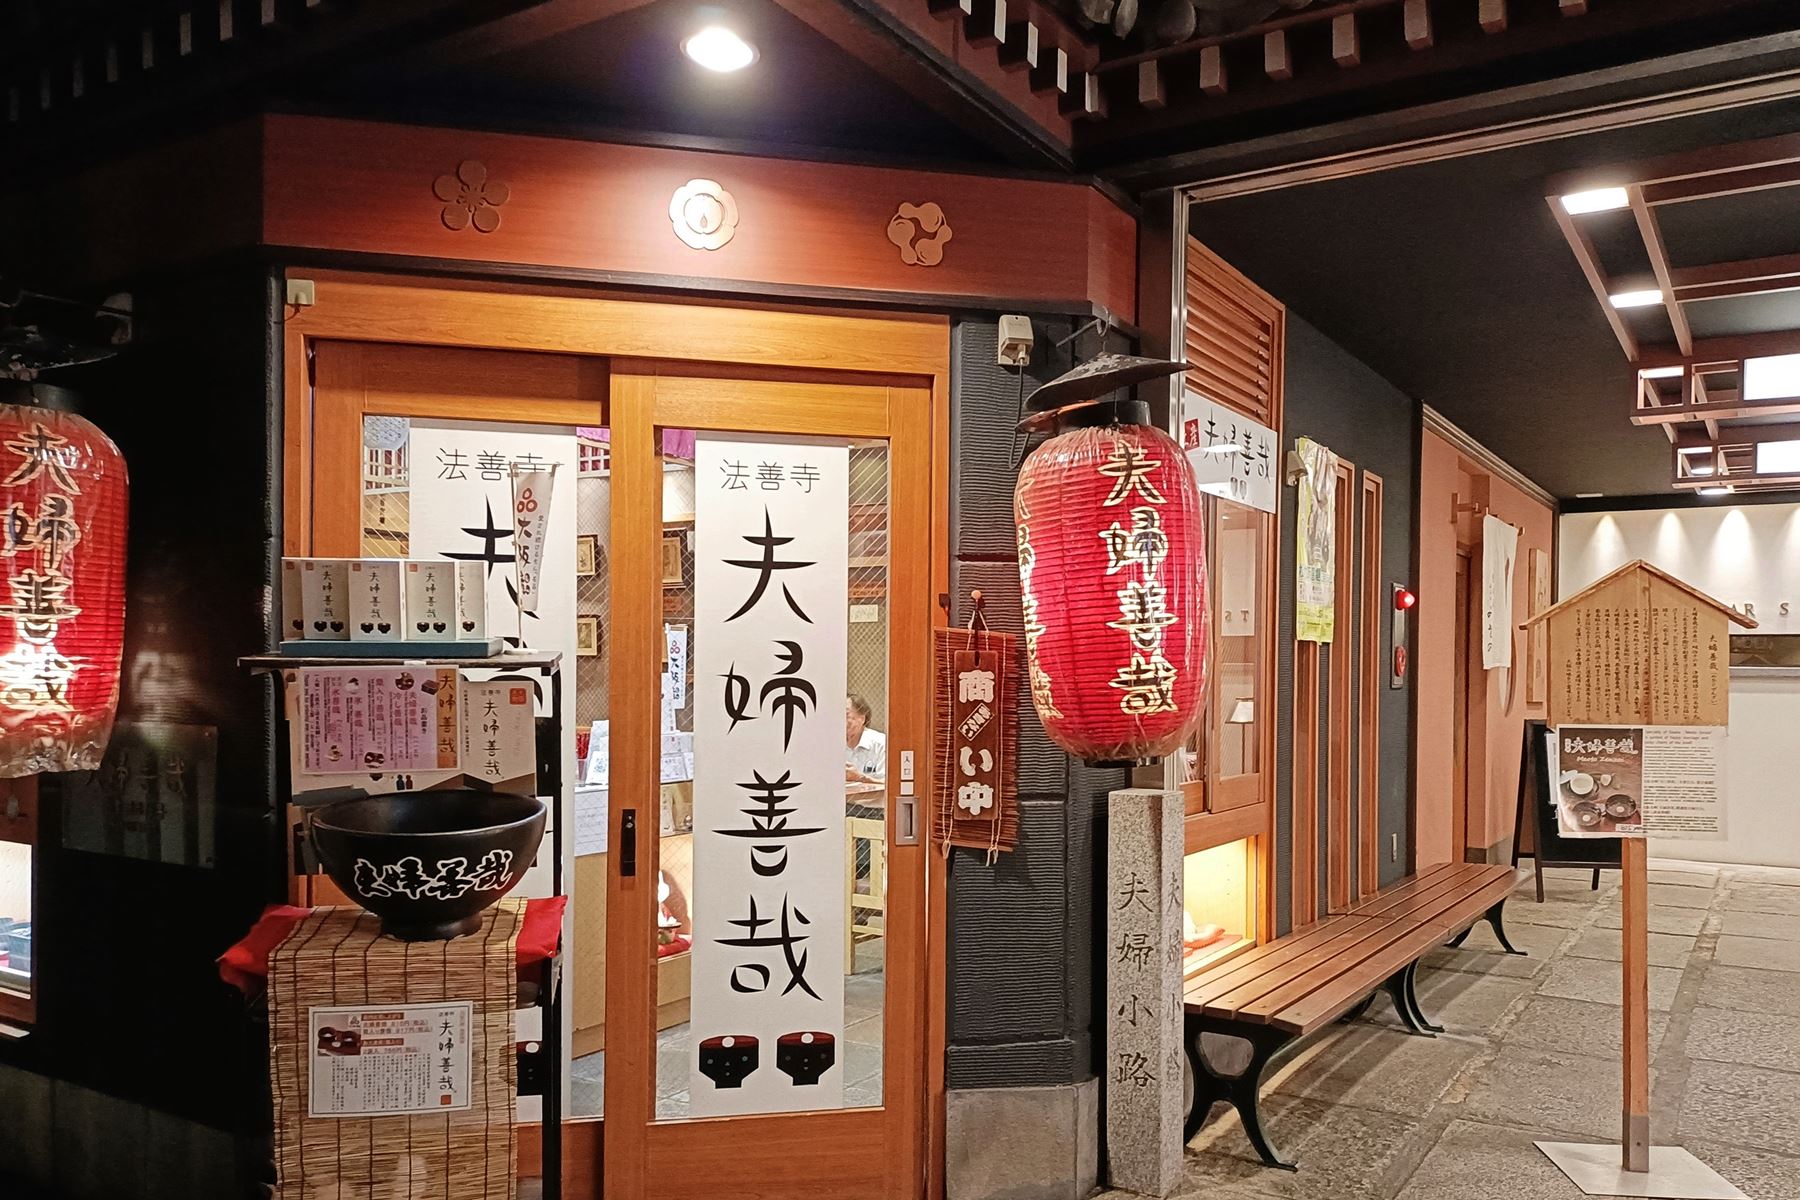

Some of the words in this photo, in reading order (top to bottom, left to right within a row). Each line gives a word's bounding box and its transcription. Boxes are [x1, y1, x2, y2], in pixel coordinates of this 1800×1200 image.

[719, 458, 821, 493] 法善寺
[1204, 407, 1271, 484] 夫婦善哉
[1098, 439, 1180, 715] 夫婦善哉
[439, 674, 456, 754] 夫婦善哉
[483, 700, 502, 776] 夫婦善哉
[711, 503, 829, 1002] 夫婦善哉
[1115, 872, 1156, 1088] 夫婦小路
[438, 1019, 455, 1091] 夫婦善哉
